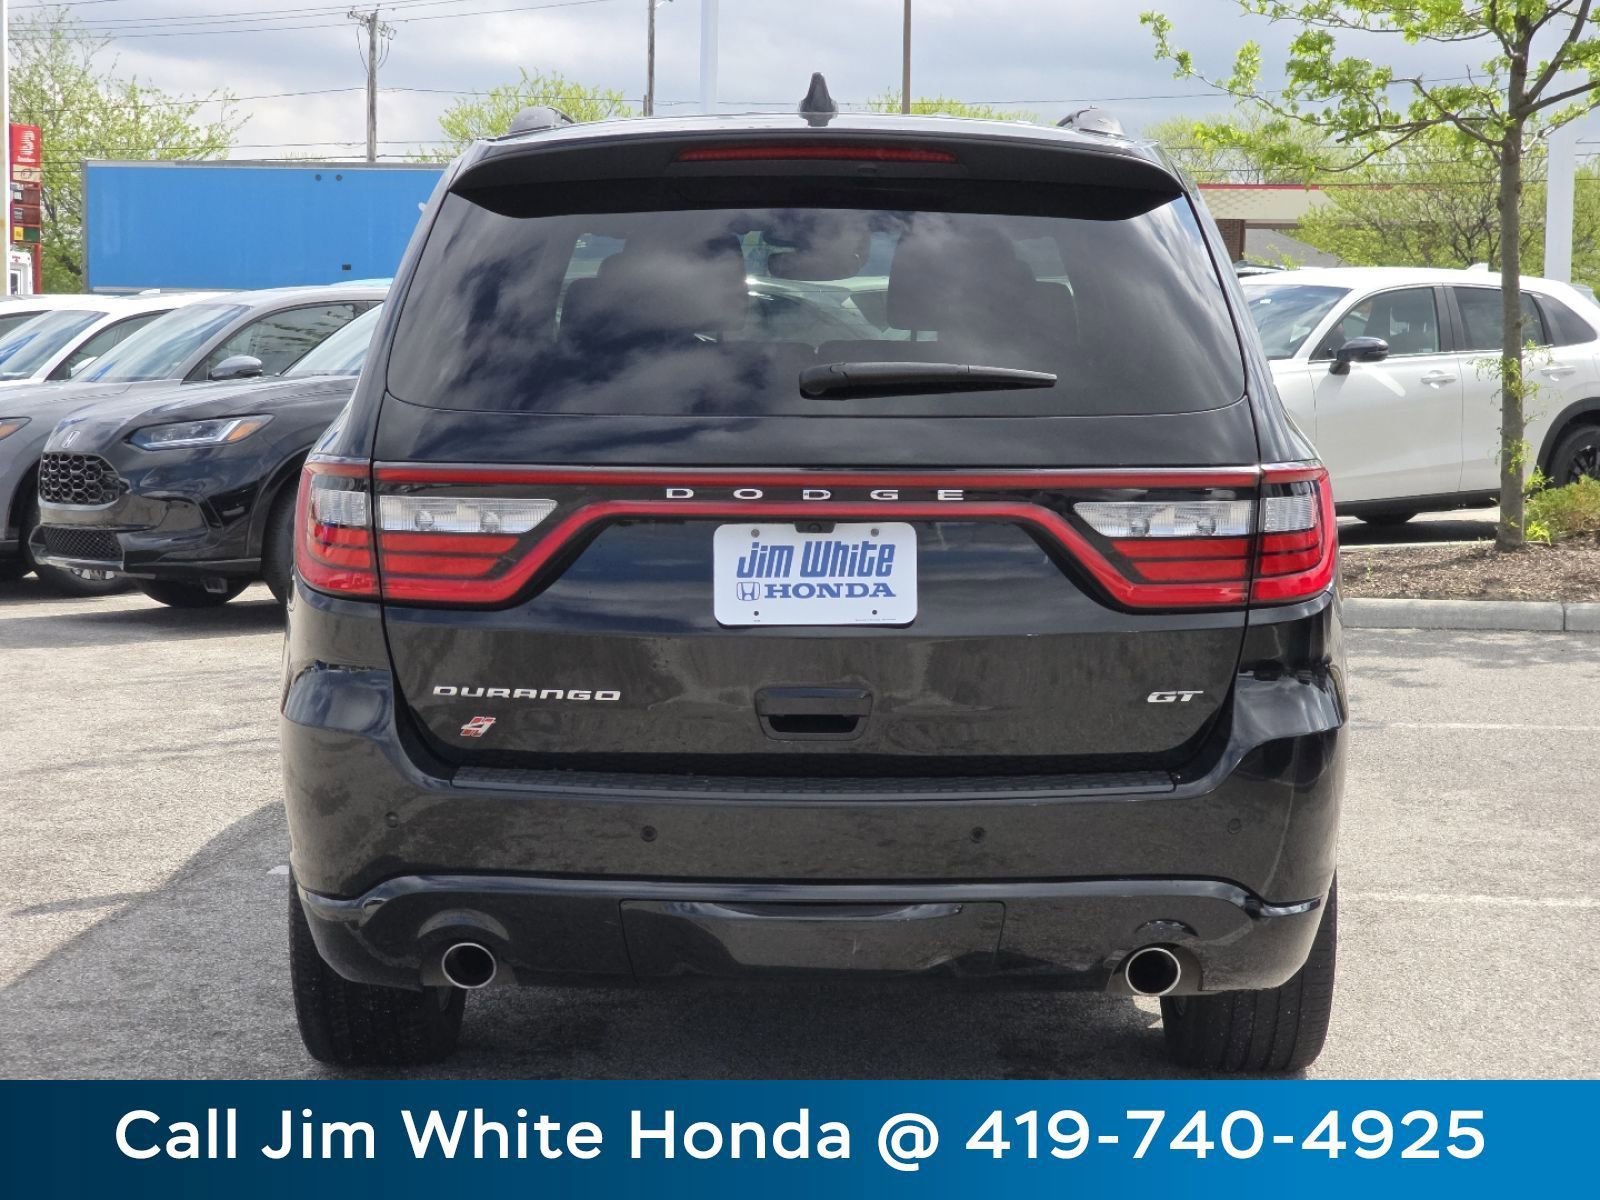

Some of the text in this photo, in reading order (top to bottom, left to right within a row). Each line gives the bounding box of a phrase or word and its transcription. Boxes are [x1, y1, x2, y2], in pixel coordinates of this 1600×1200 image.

[666, 488, 965, 500] DODGE
[736, 540, 896, 578] Jim White
[764, 582, 897, 599] HONDA
[433, 686, 621, 700] DURANGO
[1147, 690, 1204, 703] GT
